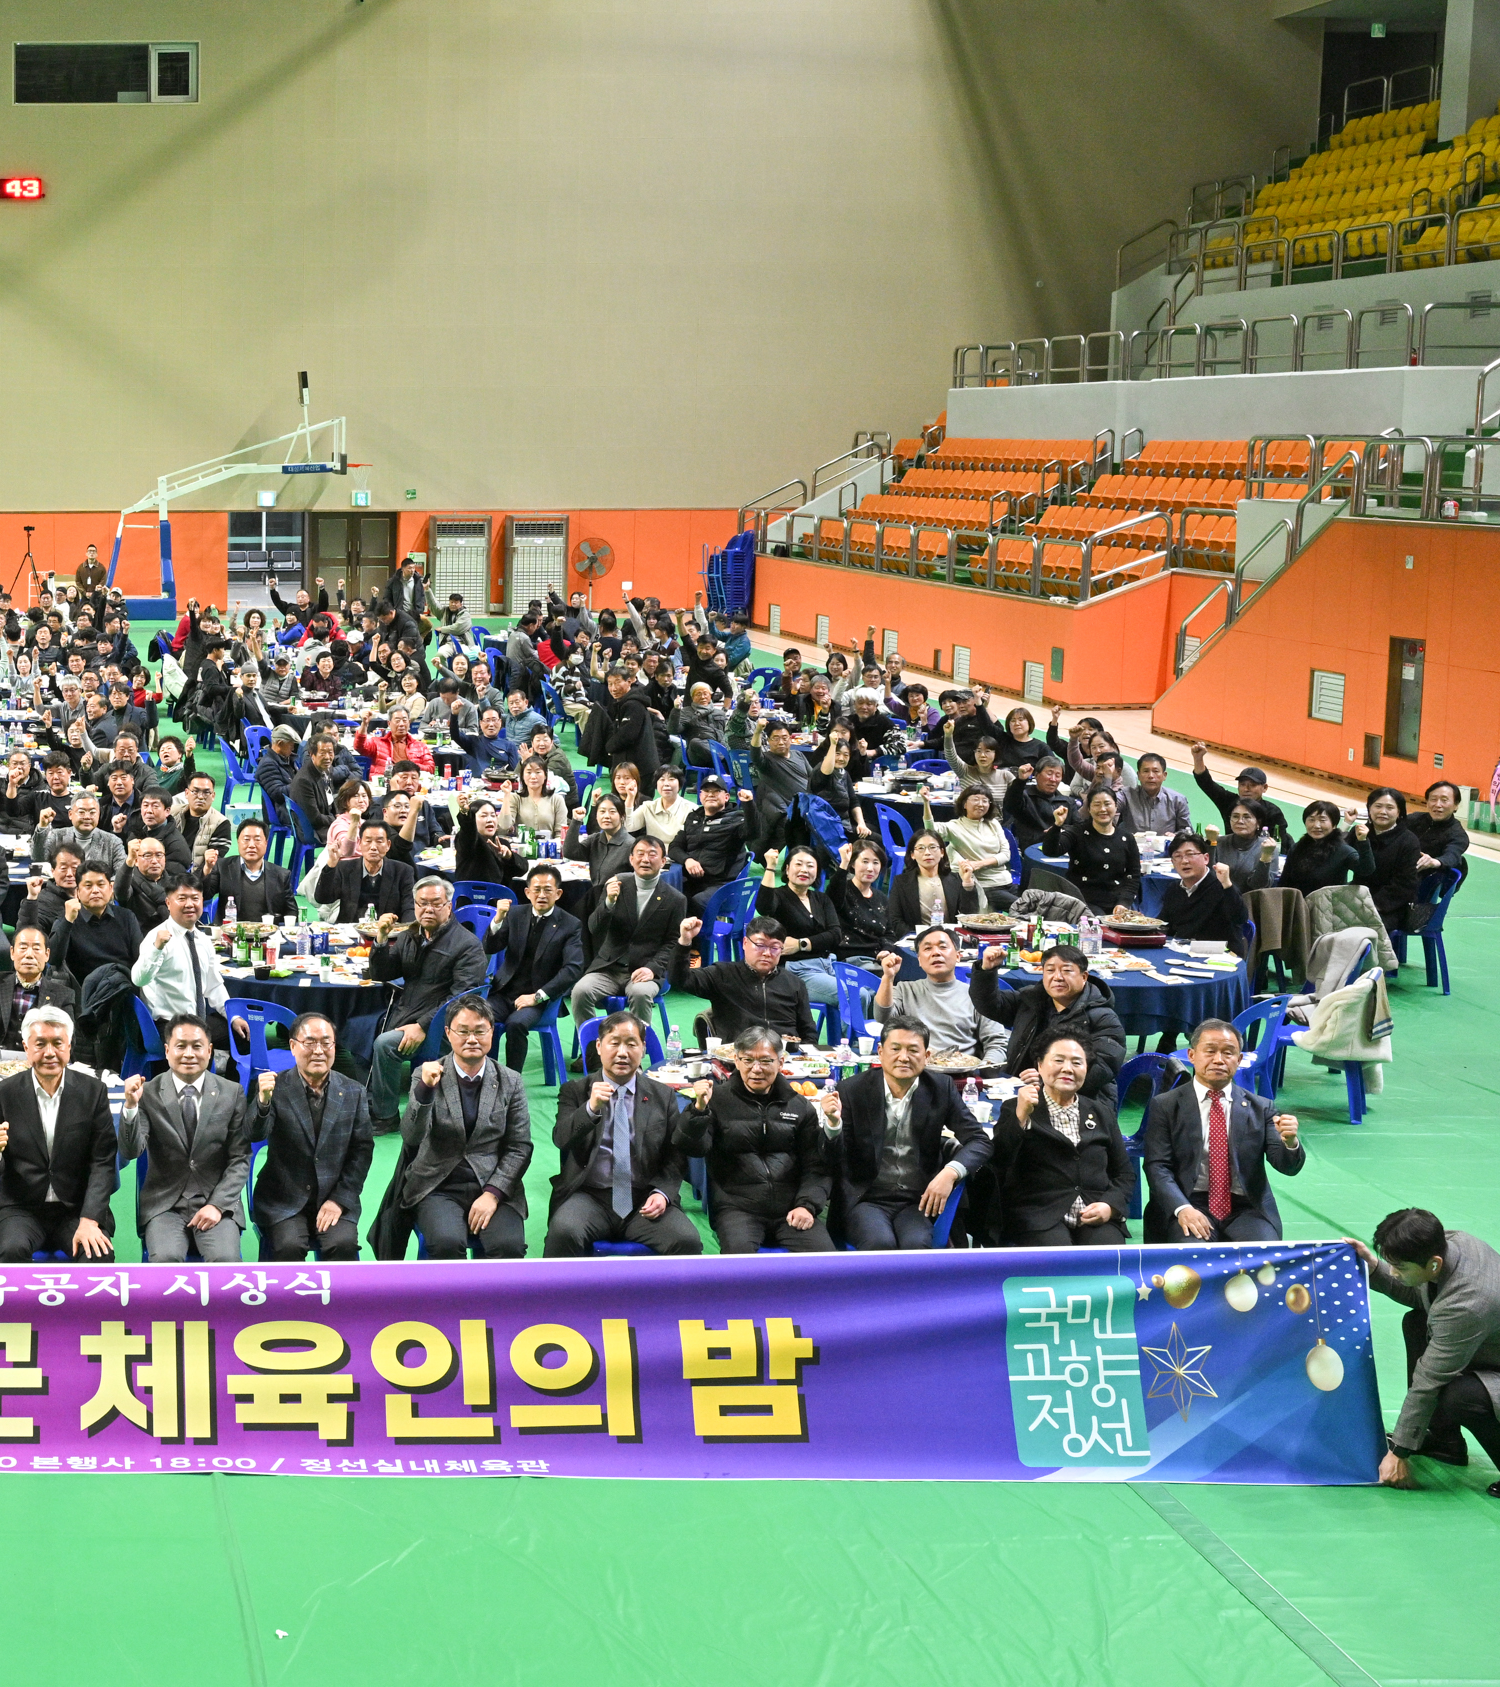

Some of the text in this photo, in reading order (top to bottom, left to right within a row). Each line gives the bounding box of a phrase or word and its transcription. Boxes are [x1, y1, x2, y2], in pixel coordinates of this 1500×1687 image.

[6, 180, 39, 197] 43
[164, 1270, 334, 1306] 시상식
[1019, 1286, 1136, 1344] 국민
[79, 1317, 638, 1439] 체육인의
[679, 1316, 814, 1438] 밤
[1009, 1340, 1140, 1407] 고향
[1027, 1390, 1151, 1457] 정선
[29, 1456, 135, 1470] 본행사
[150, 1457, 257, 1469] 18:00
[300, 1458, 550, 1474] 정선실내체육관
